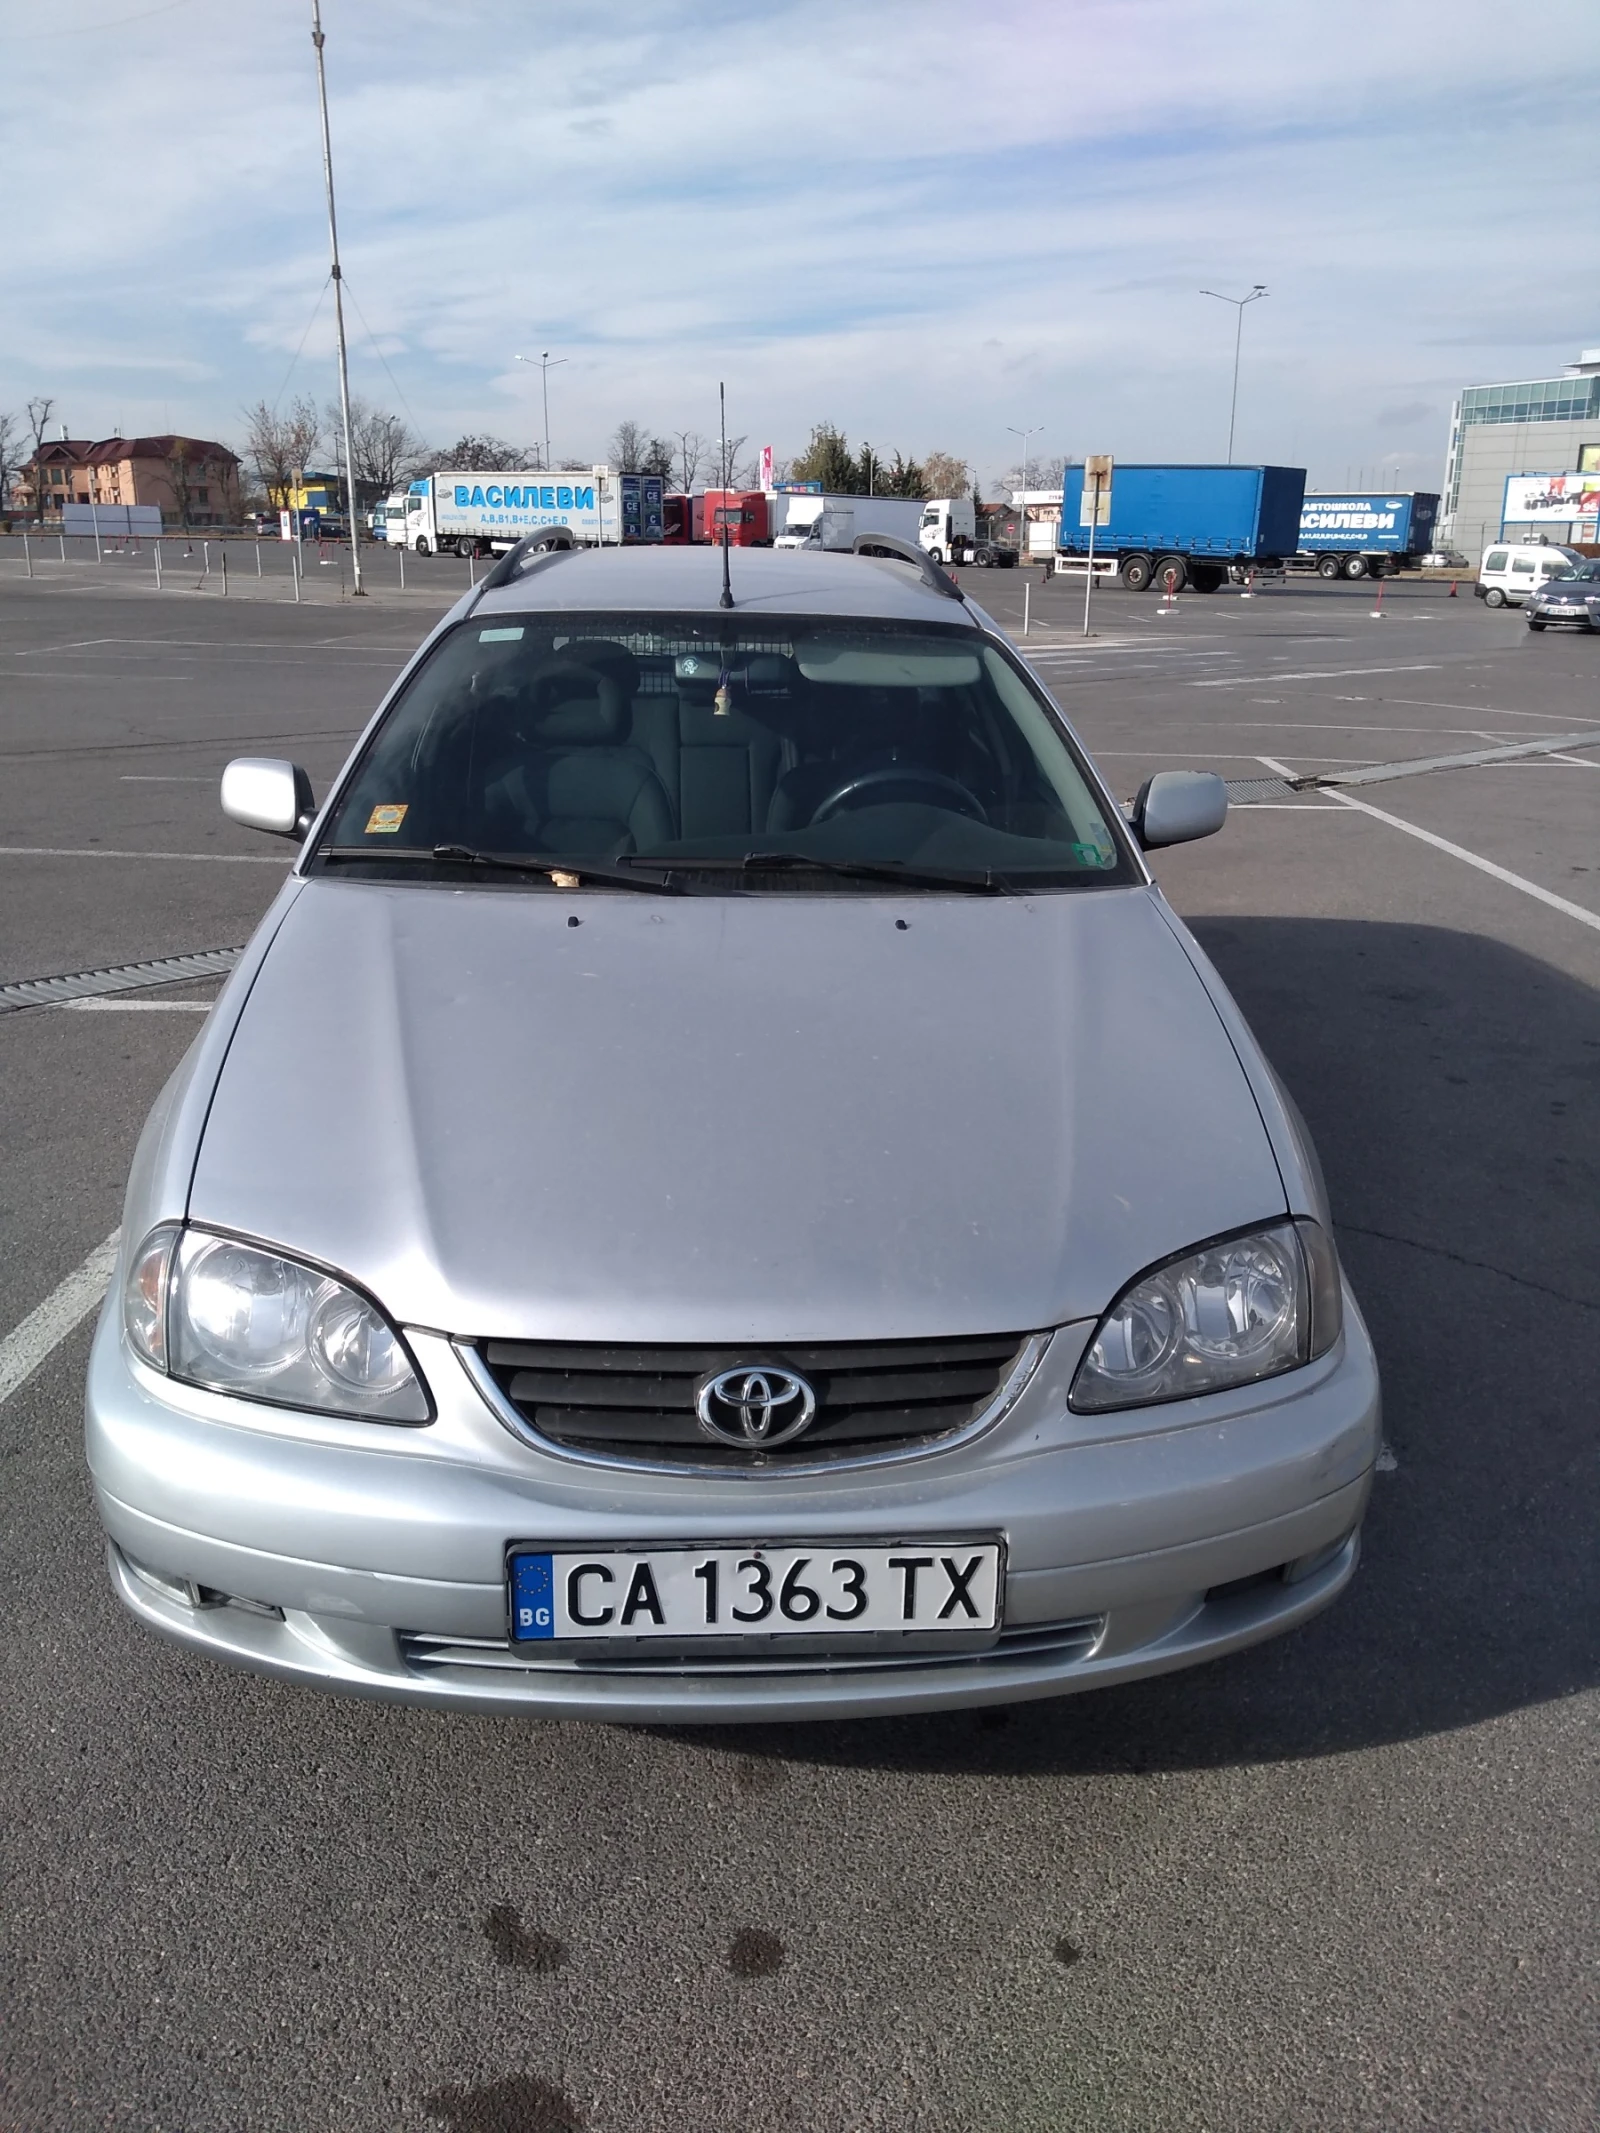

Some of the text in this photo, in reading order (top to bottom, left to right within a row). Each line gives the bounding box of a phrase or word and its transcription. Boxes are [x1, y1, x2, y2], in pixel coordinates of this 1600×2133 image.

[454, 485, 594, 510] ВАСИЛЕВИ
[647, 492, 658, 500] CE
[626, 502, 638, 511] CE
[1302, 503, 1371, 511] АВТОШКОЛА
[1300, 513, 1395, 529] СИЛЕВИ
[567, 1555, 983, 1627] CA 1363 TX
[520, 1607, 550, 1626] BG
